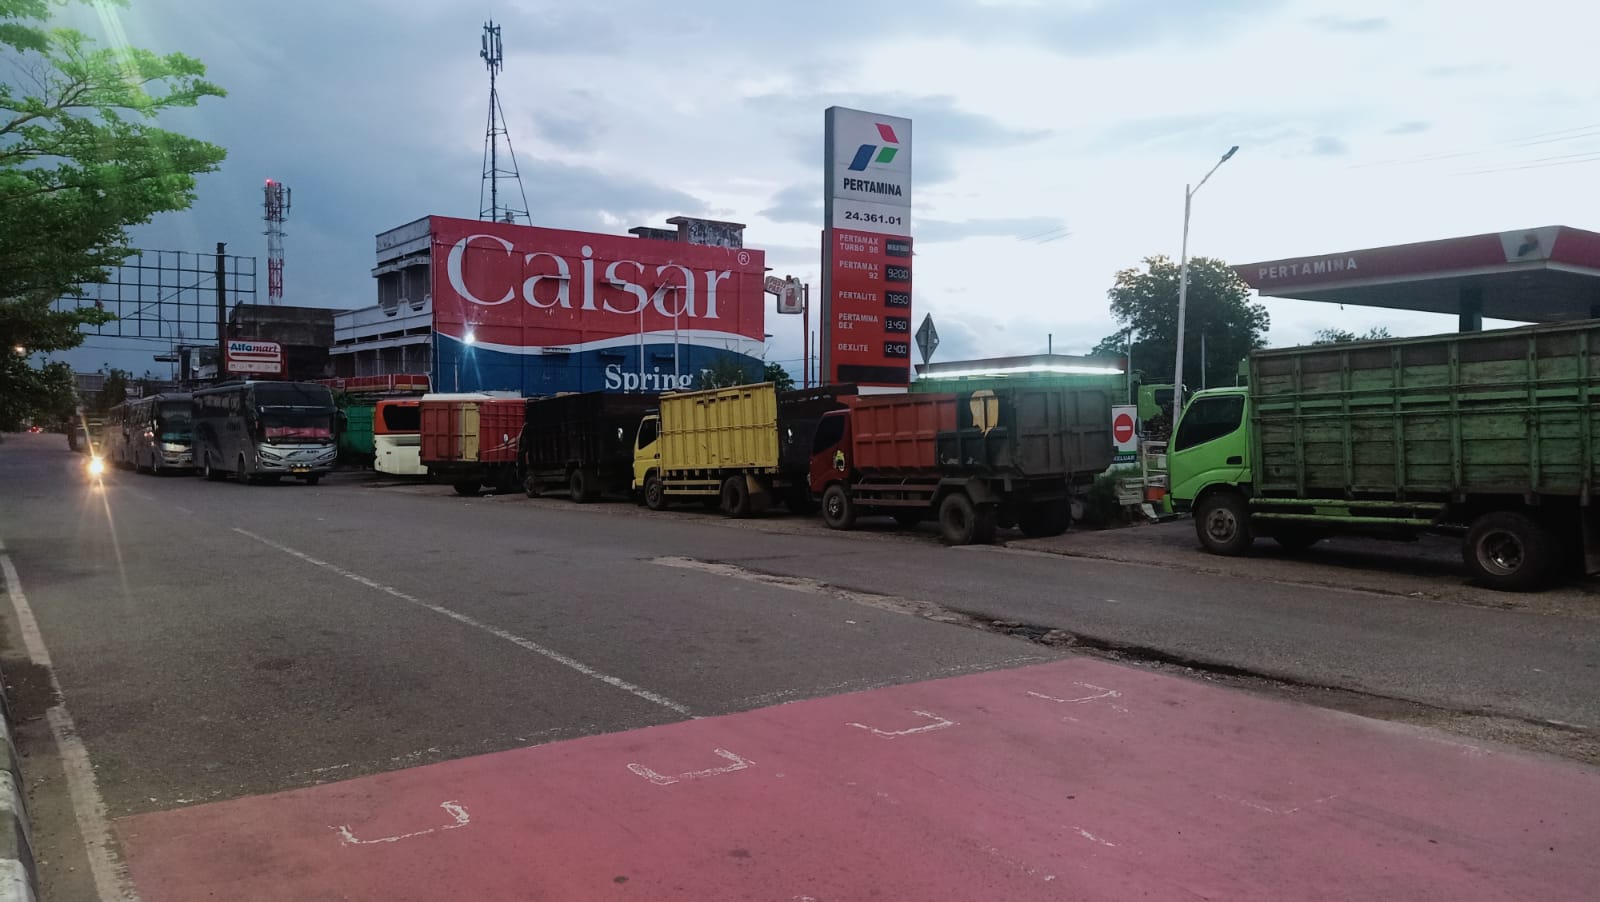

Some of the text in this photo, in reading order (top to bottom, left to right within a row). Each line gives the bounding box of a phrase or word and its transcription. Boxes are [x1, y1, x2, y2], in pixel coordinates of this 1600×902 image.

[843, 177, 902, 197] PERTAMINA
[844, 211, 902, 226] 24.361.01
[839, 233, 878, 246] PERTAMAX
[839, 243, 865, 252] TURBO
[839, 260, 878, 271] PERTAMAX
[1258, 256, 1358, 280] PERTAMINA
[447, 234, 732, 319] Caisar
[868, 267, 909, 280] 92 9200
[838, 290, 909, 305] PERTALITE 7850
[838, 312, 878, 323] PERTAMINA
[838, 321, 853, 330] DEX
[230, 342, 279, 354] Alfamart
[838, 343, 869, 352] DEXLITE
[604, 363, 694, 395] Spring
